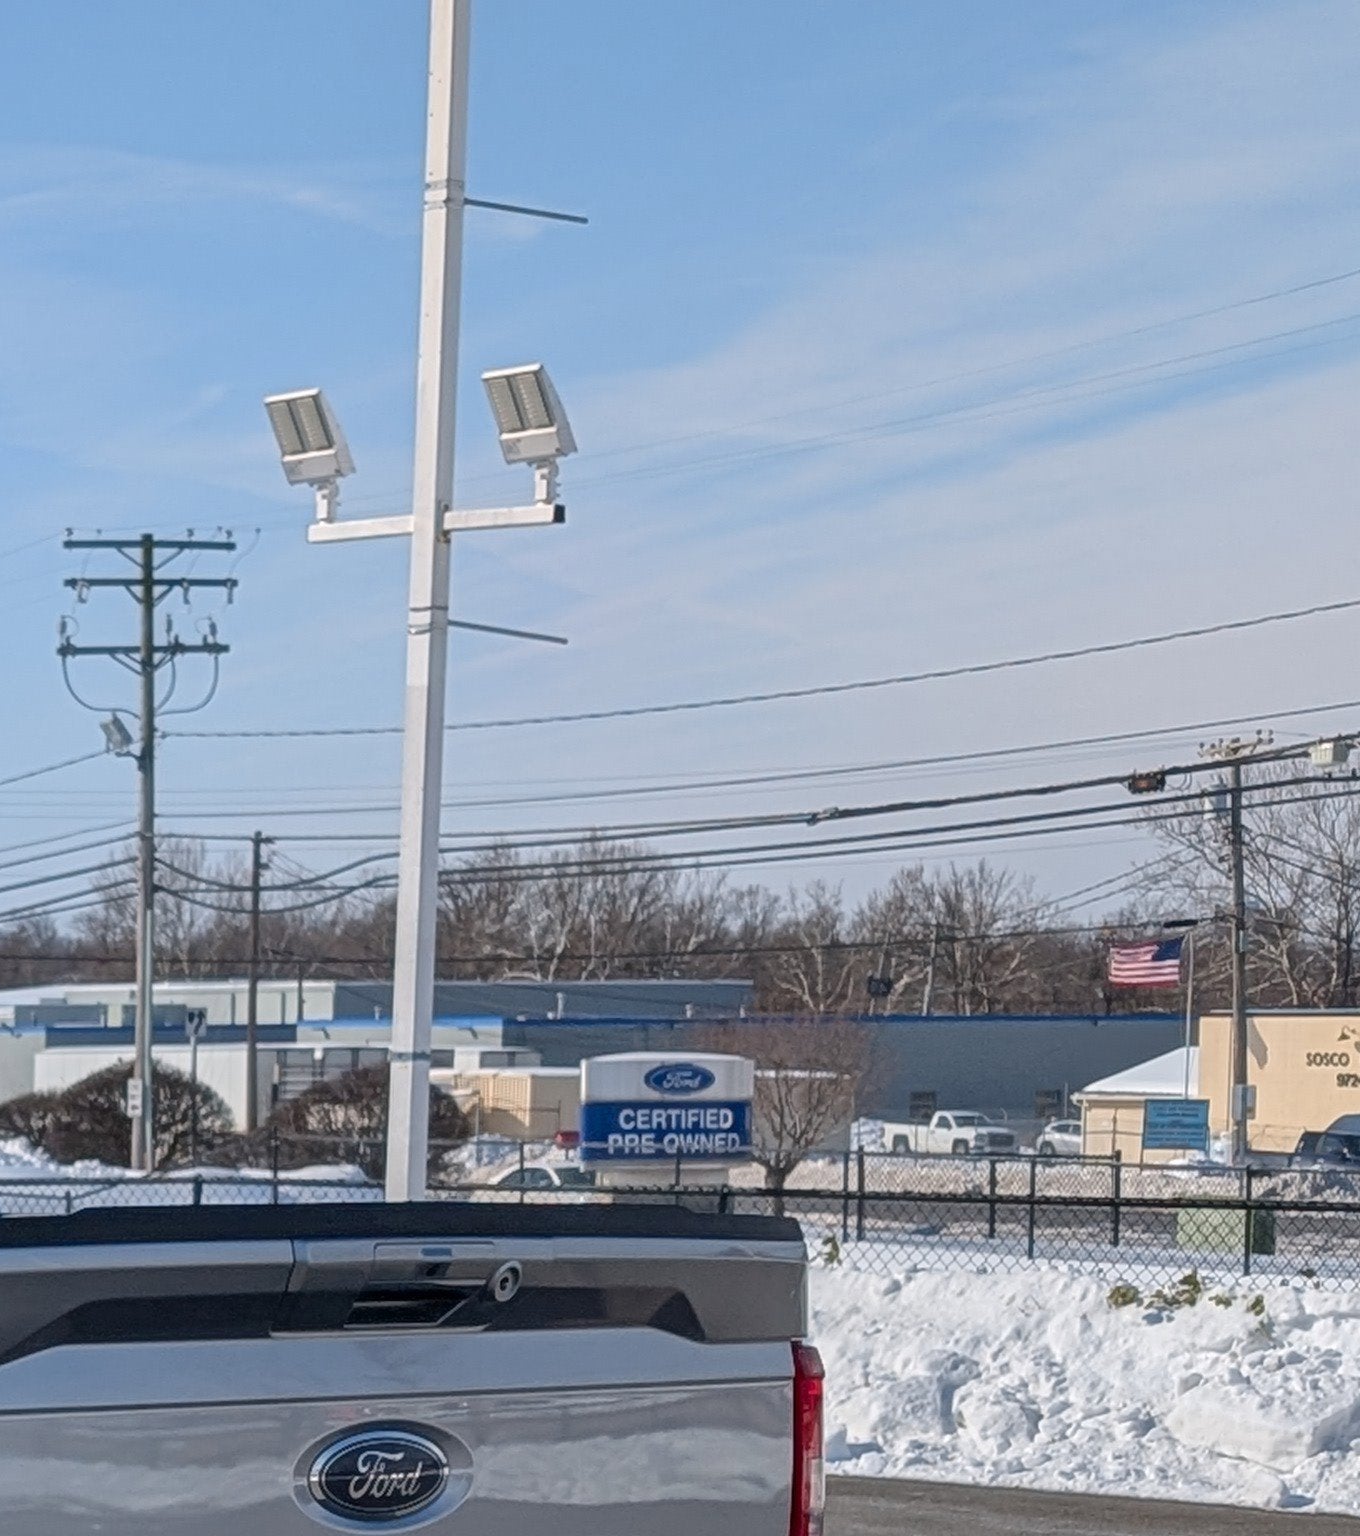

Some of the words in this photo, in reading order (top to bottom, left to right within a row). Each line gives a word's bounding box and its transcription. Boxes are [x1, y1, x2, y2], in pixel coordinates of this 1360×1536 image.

[1306, 1052, 1350, 1067] SOSCO
[662, 1070, 702, 1089] Ford
[618, 1108, 734, 1130] CERTIFIED
[607, 1132, 741, 1155] PREOWNED
[348, 1450, 423, 1499] Ford
